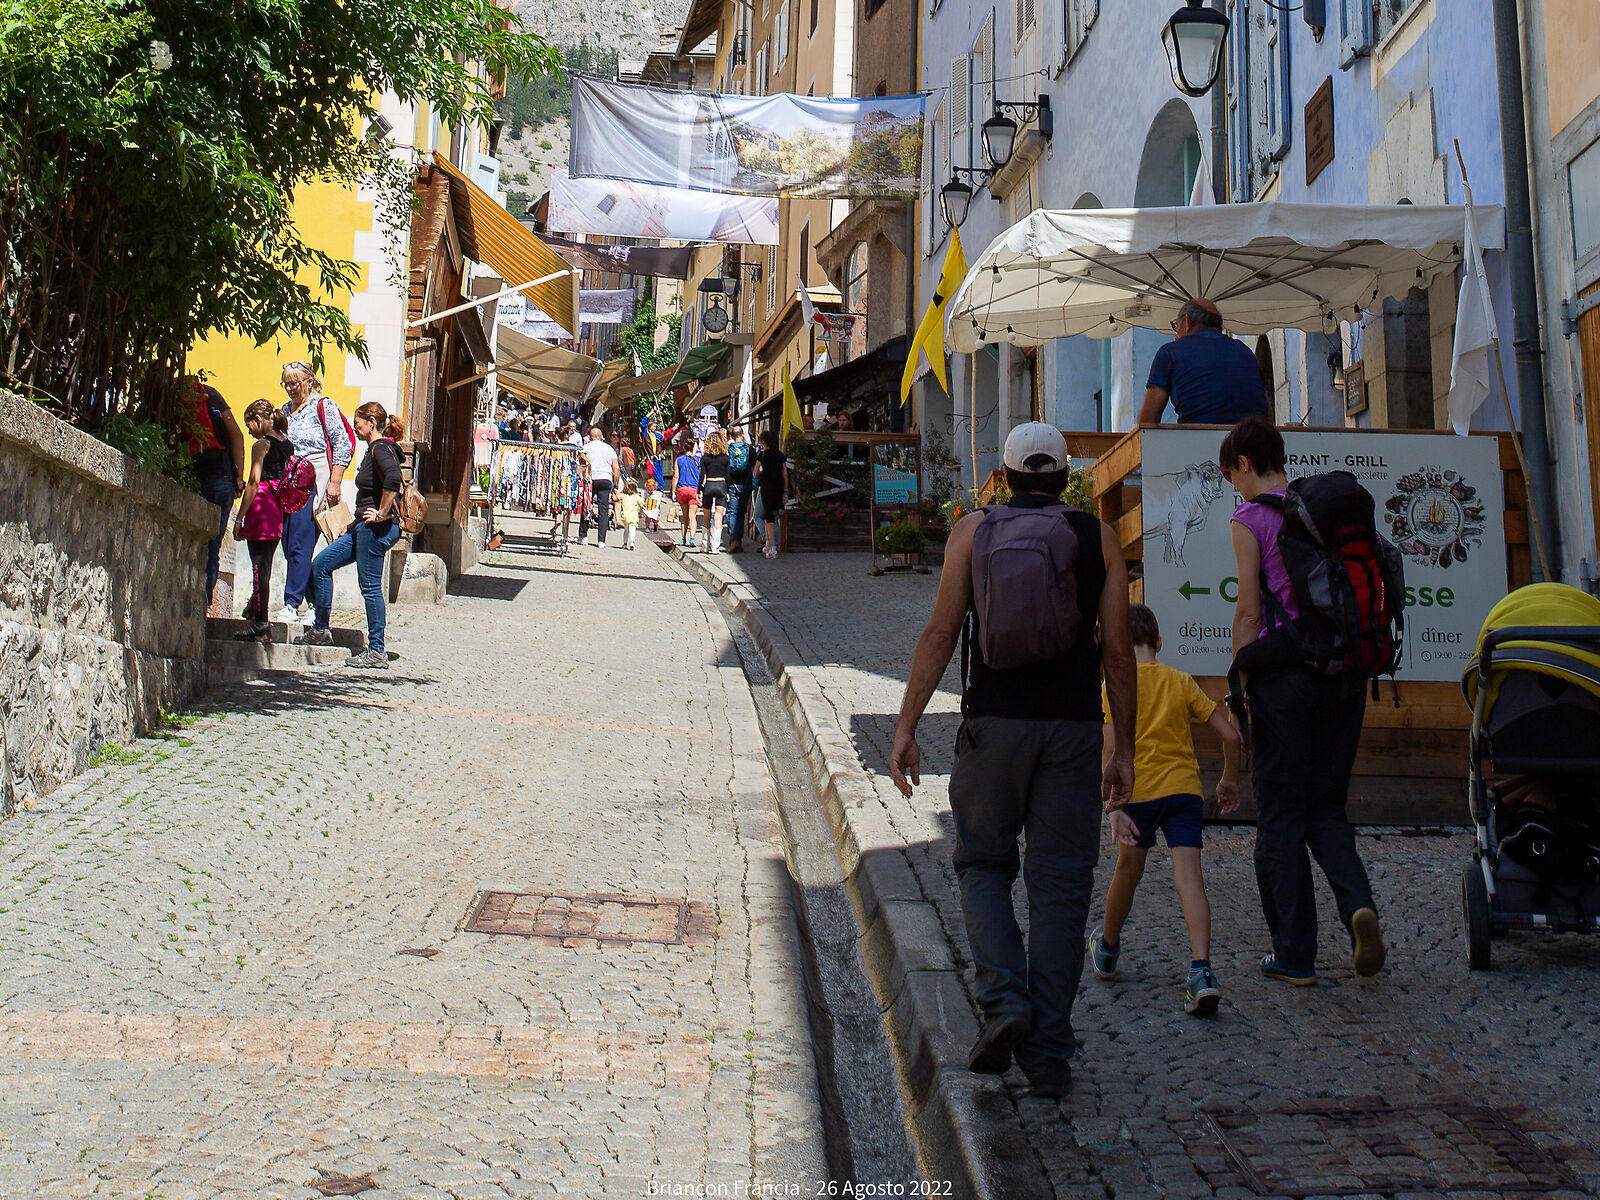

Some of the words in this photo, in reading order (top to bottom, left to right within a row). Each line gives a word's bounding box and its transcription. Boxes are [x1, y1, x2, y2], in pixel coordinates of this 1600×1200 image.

[1344, 455, 1388, 467] GRILL
[1290, 468, 1301, 478] De
[1303, 468, 1311, 478] la
[1405, 586, 1455, 608] sse
[1179, 622, 1232, 642] déjeun
[1421, 627, 1463, 643] dîner
[1191, 646, 1210, 654] 12:00
[1434, 651, 1453, 659] 19:00
